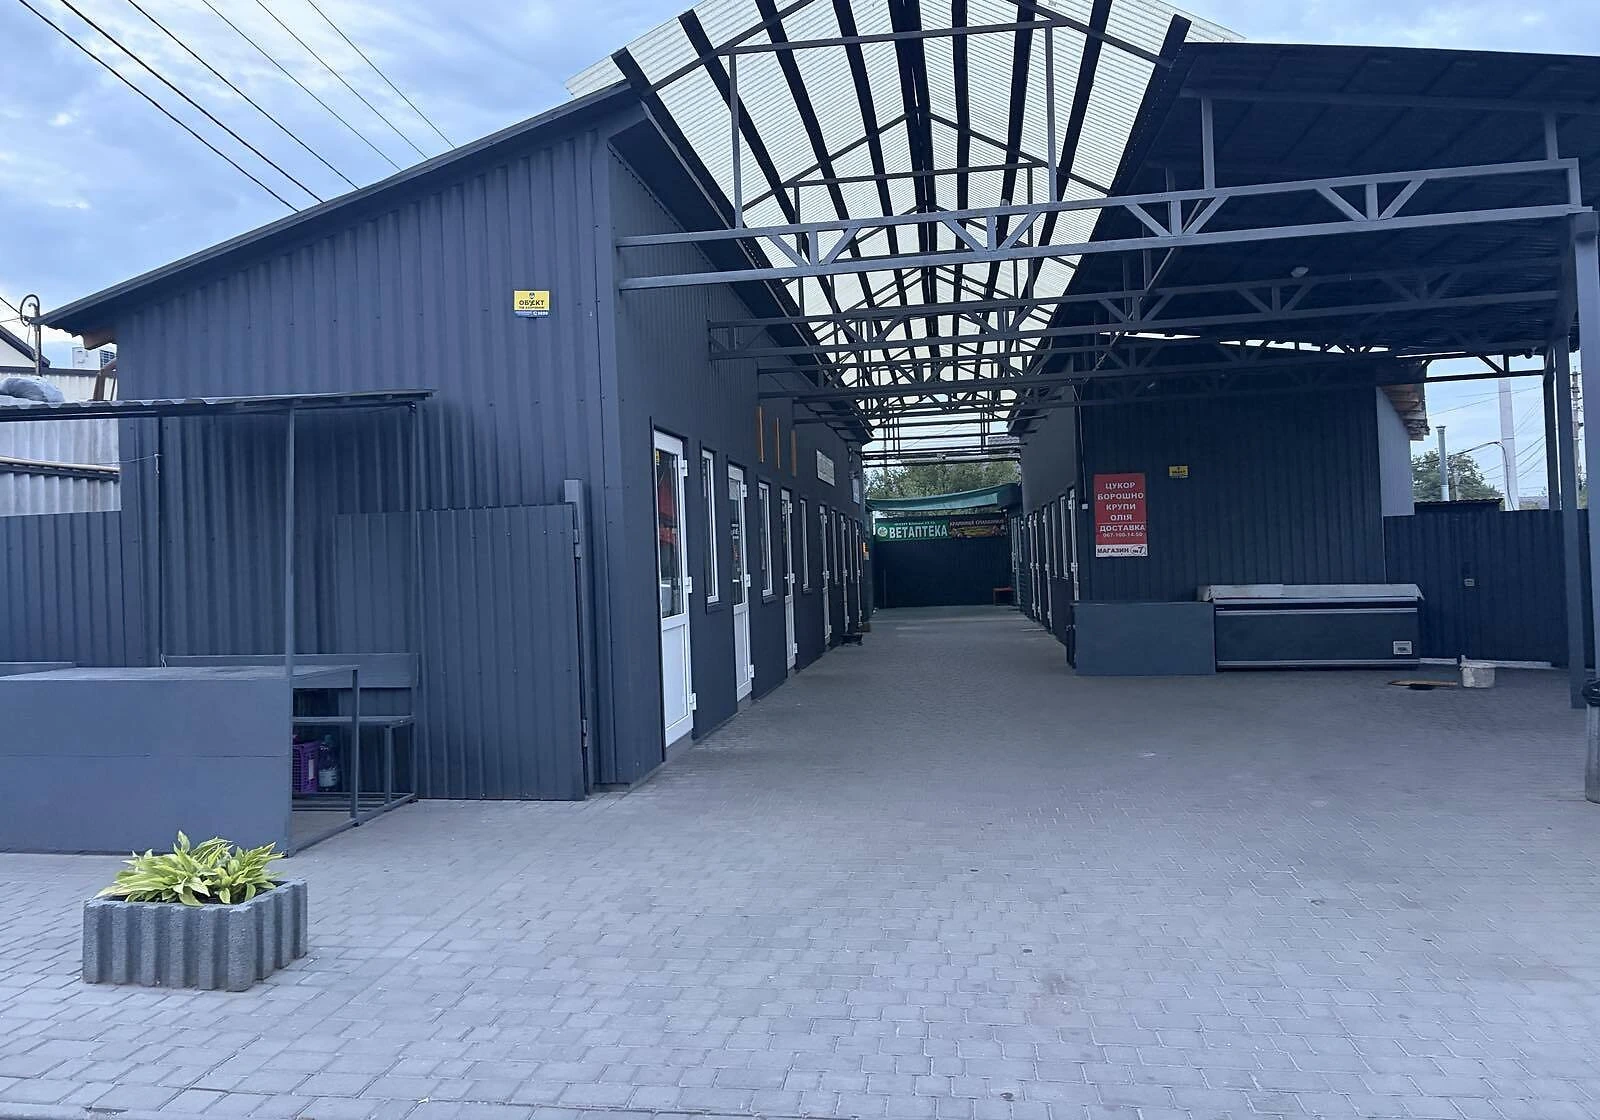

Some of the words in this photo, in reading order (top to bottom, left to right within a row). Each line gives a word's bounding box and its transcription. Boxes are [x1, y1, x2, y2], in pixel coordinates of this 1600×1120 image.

[1105, 482, 1136, 490] ЦУКОР
[1106, 503, 1136, 511] КРУПИ
[889, 524, 948, 539] ВЕТАПТЕКА
